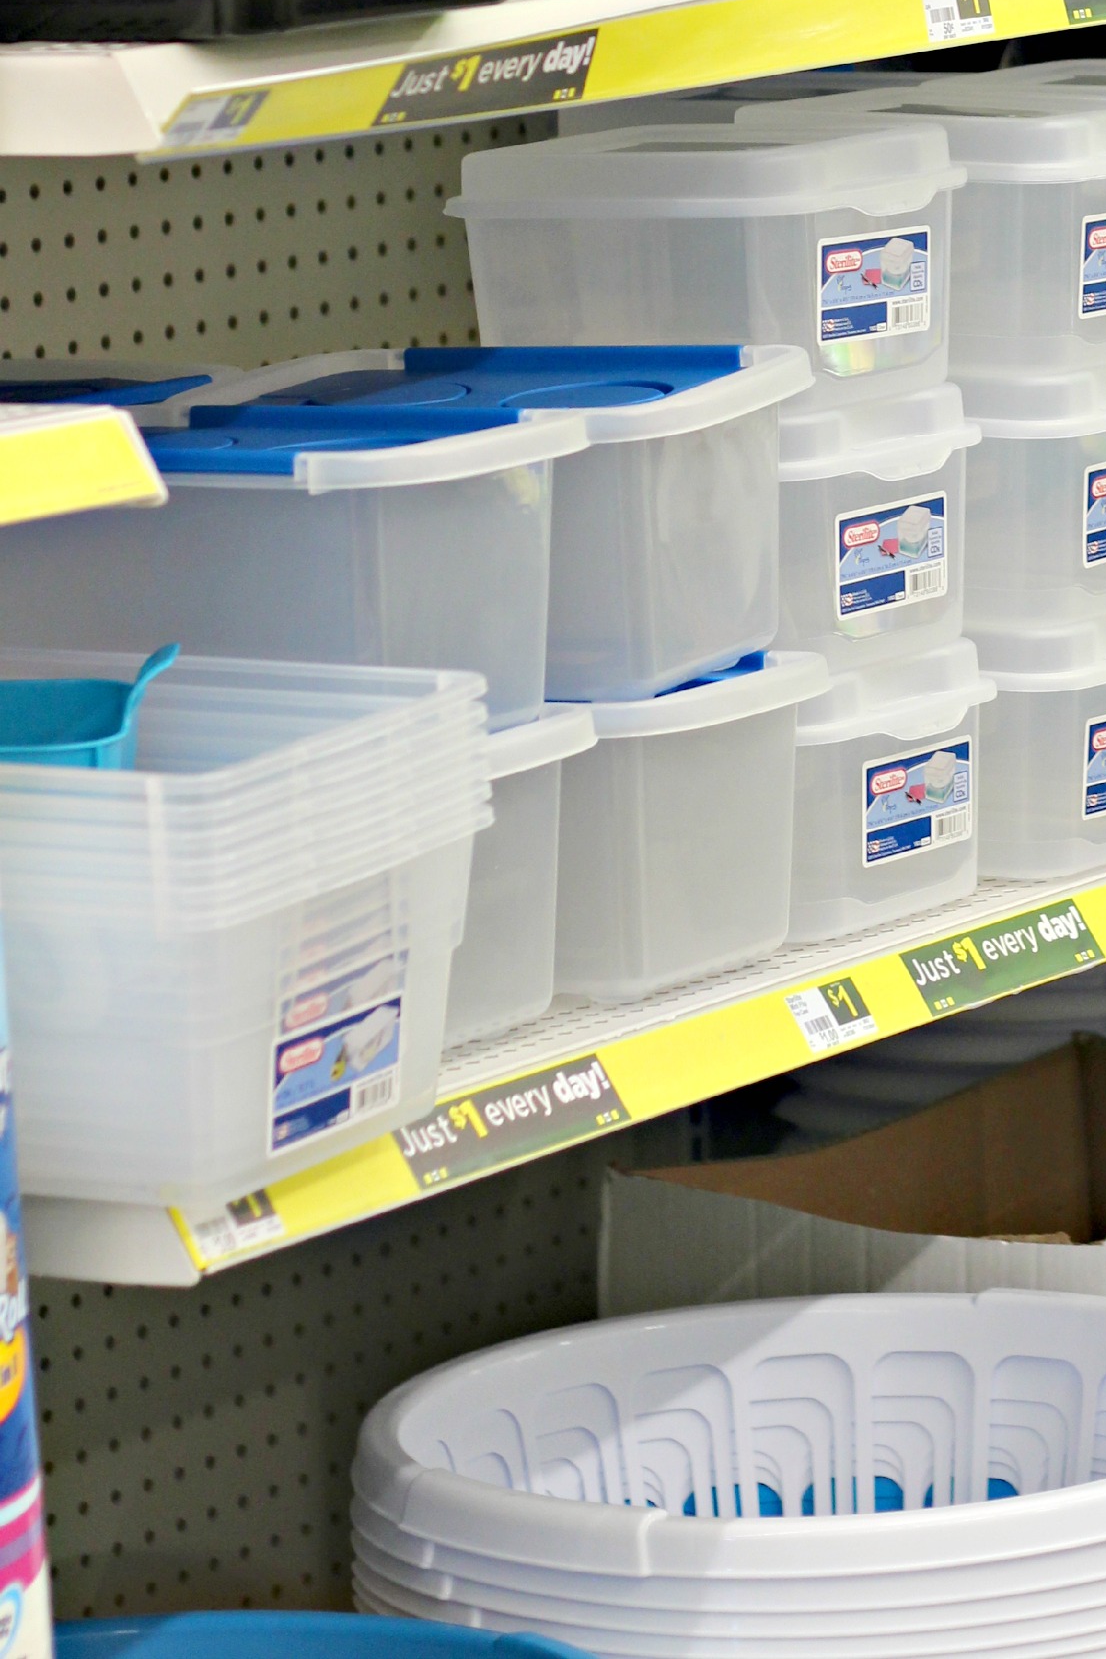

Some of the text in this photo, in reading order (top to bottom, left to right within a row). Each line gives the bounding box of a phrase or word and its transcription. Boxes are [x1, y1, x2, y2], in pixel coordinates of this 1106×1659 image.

[389, 36, 596, 98] Just $1 every day!
[829, 254, 858, 270] Sterilite
[912, 905, 1087, 987] Just $1 every day!
[827, 984, 858, 1017] $1
[400, 1060, 610, 1158] Just $1 every day!
